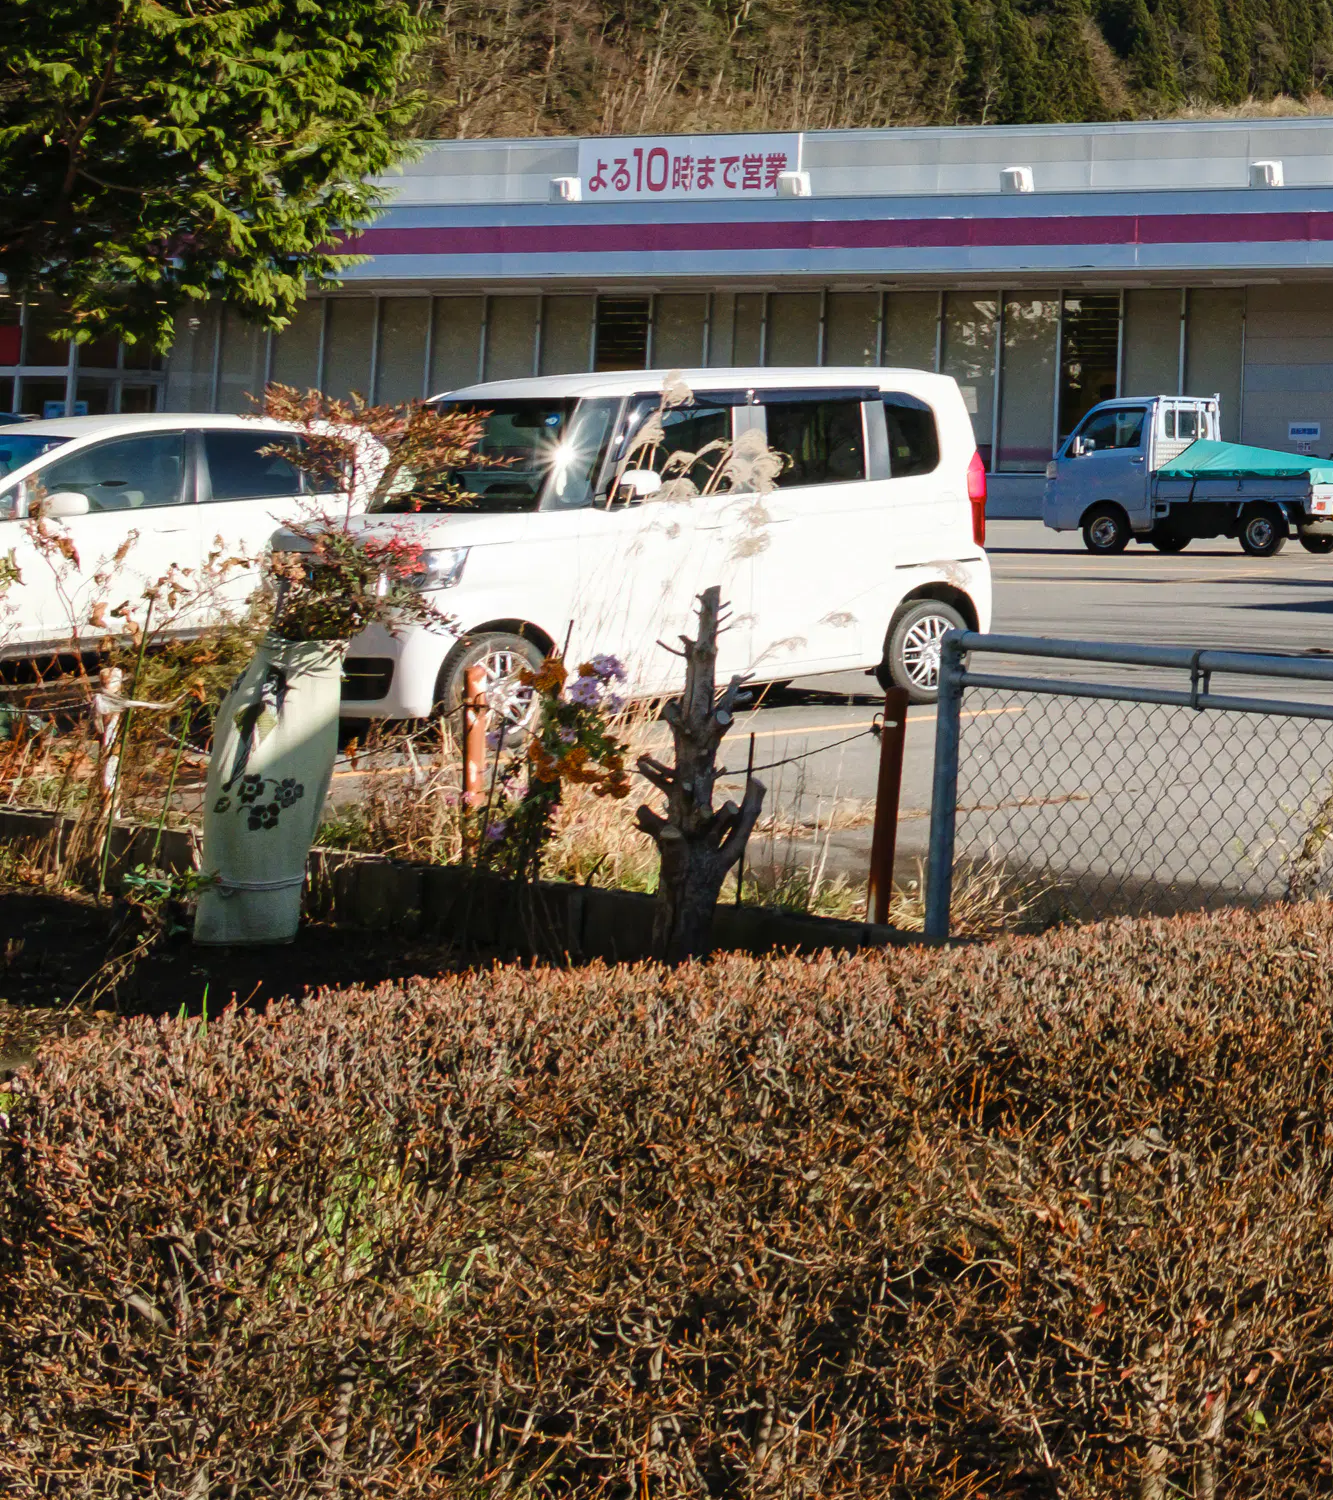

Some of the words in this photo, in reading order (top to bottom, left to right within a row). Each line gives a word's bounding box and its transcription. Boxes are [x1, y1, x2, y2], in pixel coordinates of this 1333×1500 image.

[588, 147, 788, 193] よる10時まで営業
